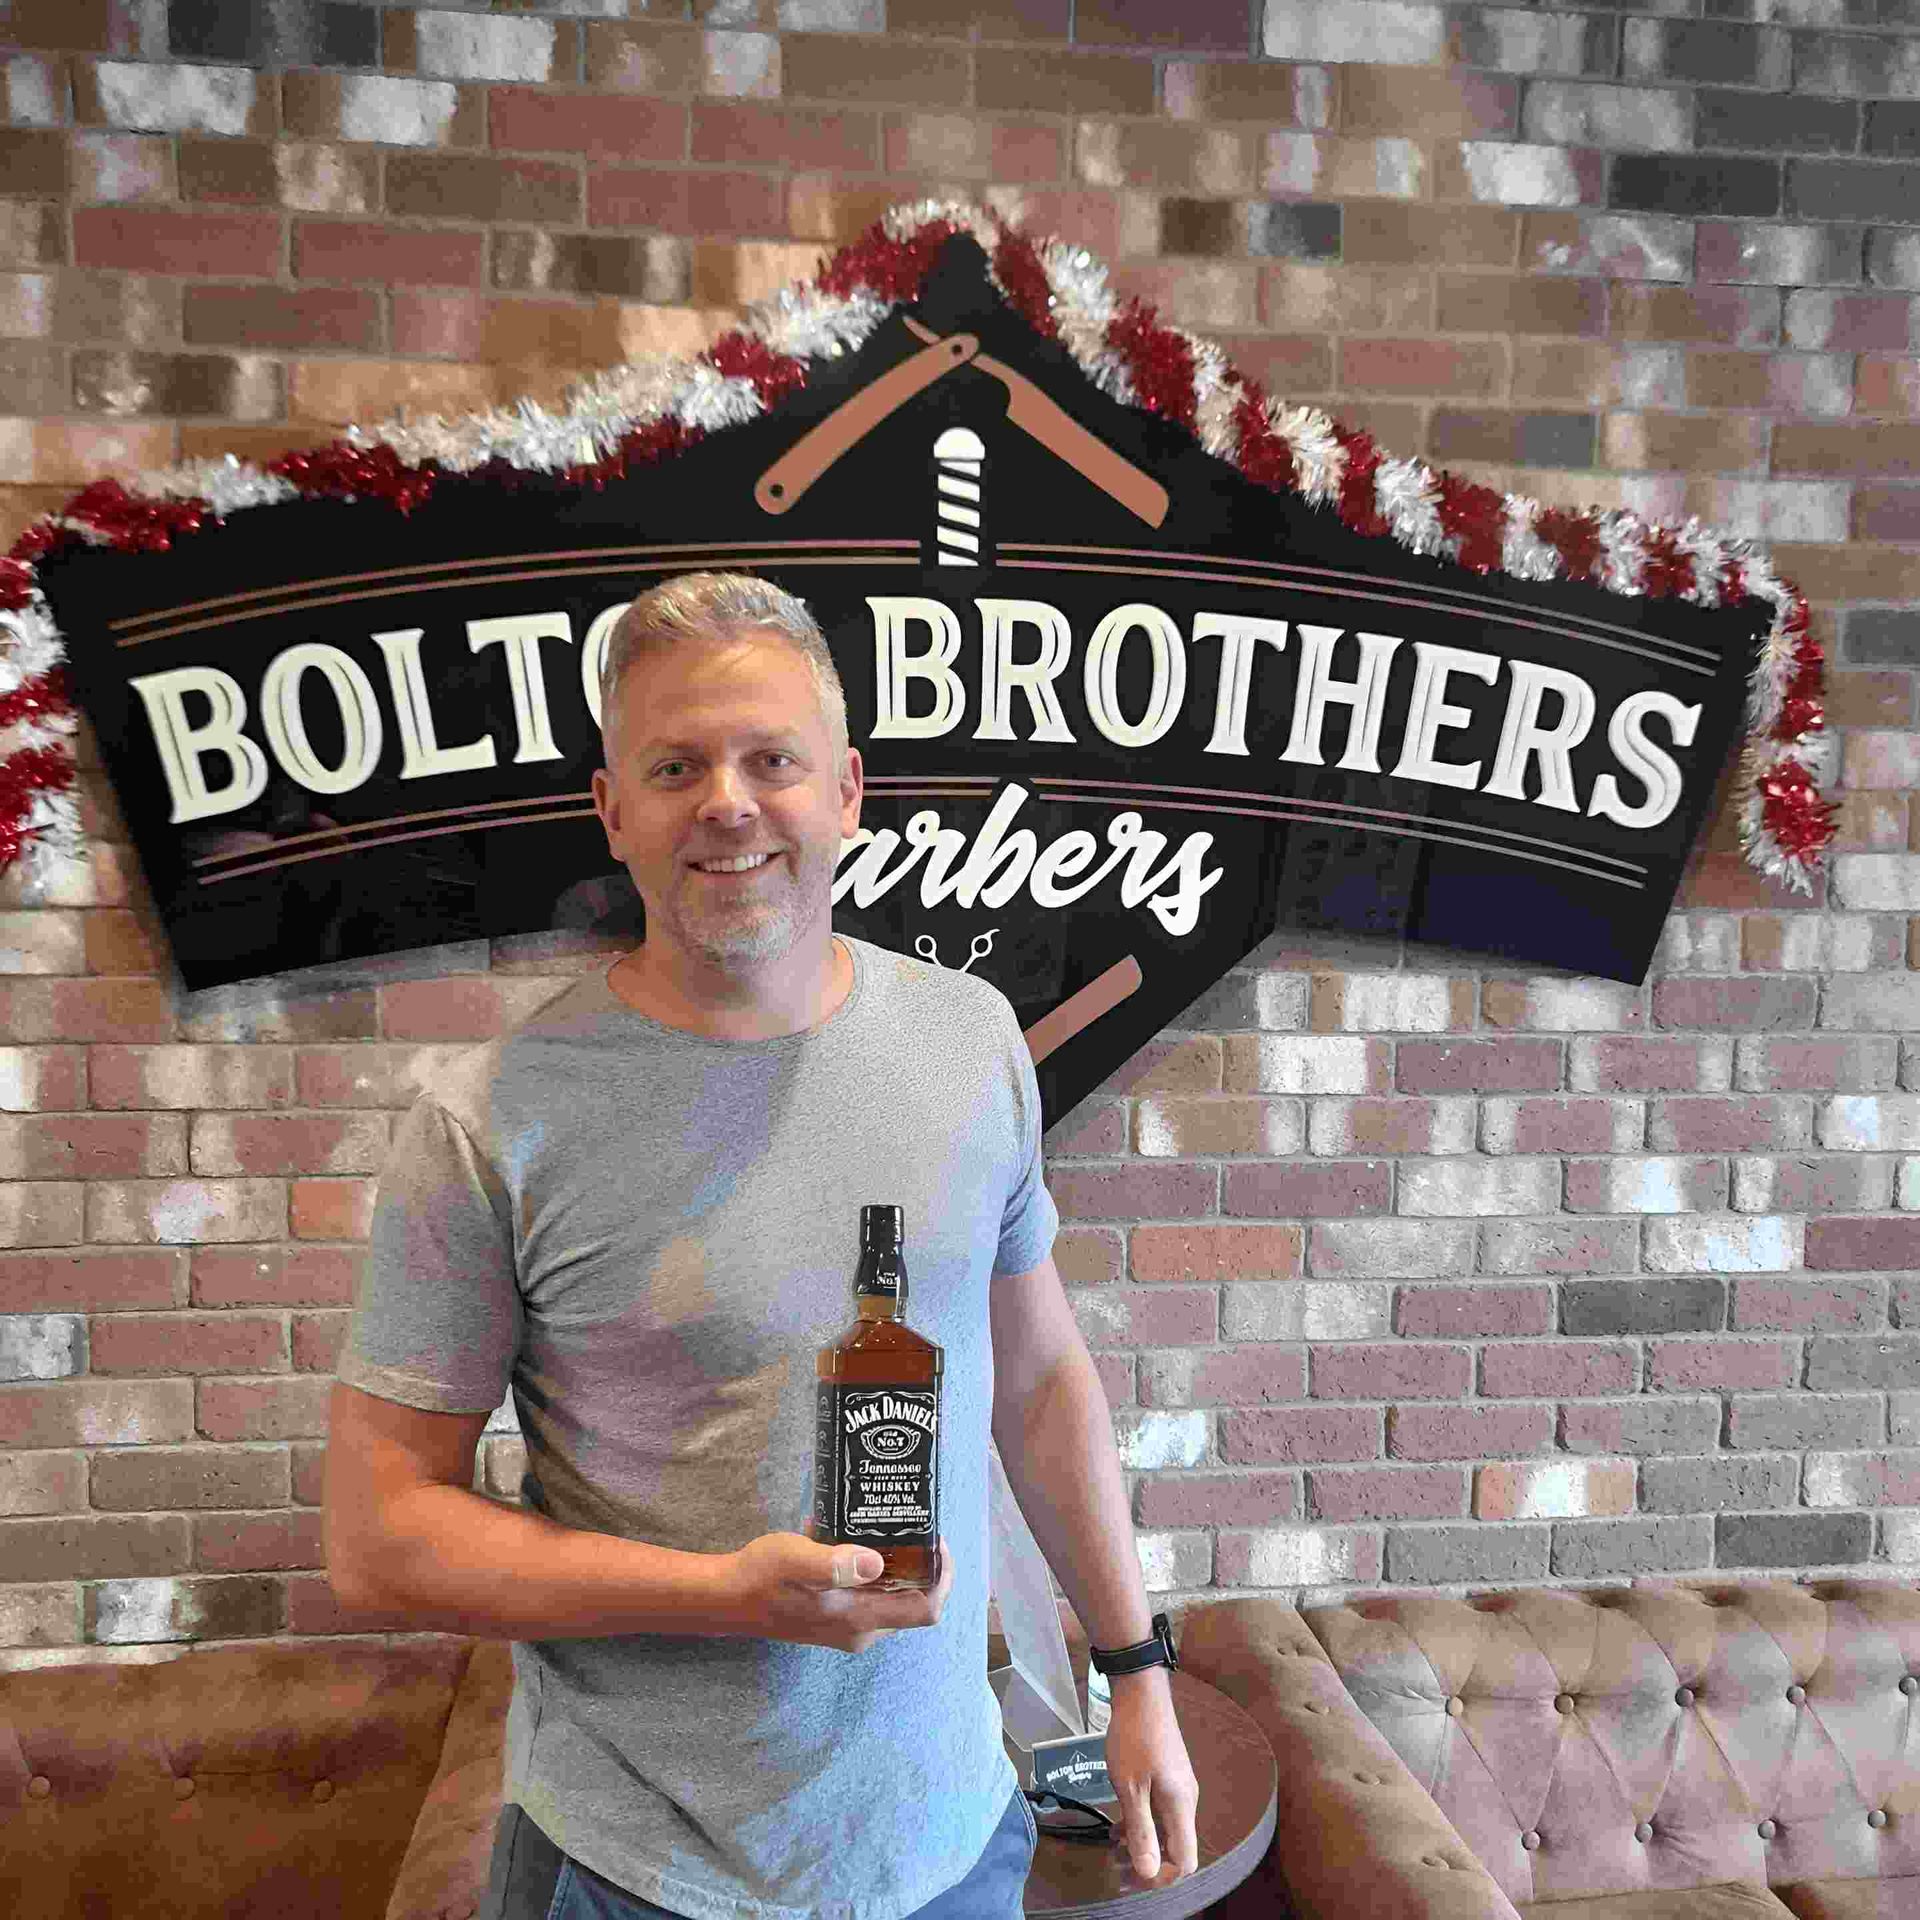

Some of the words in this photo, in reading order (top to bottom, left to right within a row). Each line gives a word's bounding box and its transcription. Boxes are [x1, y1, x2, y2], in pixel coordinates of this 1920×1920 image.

[128, 598, 633, 825] BOLT
[865, 596, 1704, 830] BROTHERS
[831, 782, 1224, 937] arbers
[844, 1402, 882, 1434] JACK
[859, 1459, 922, 1474] Tennessee
[860, 1481, 921, 1492] WHISKEY
